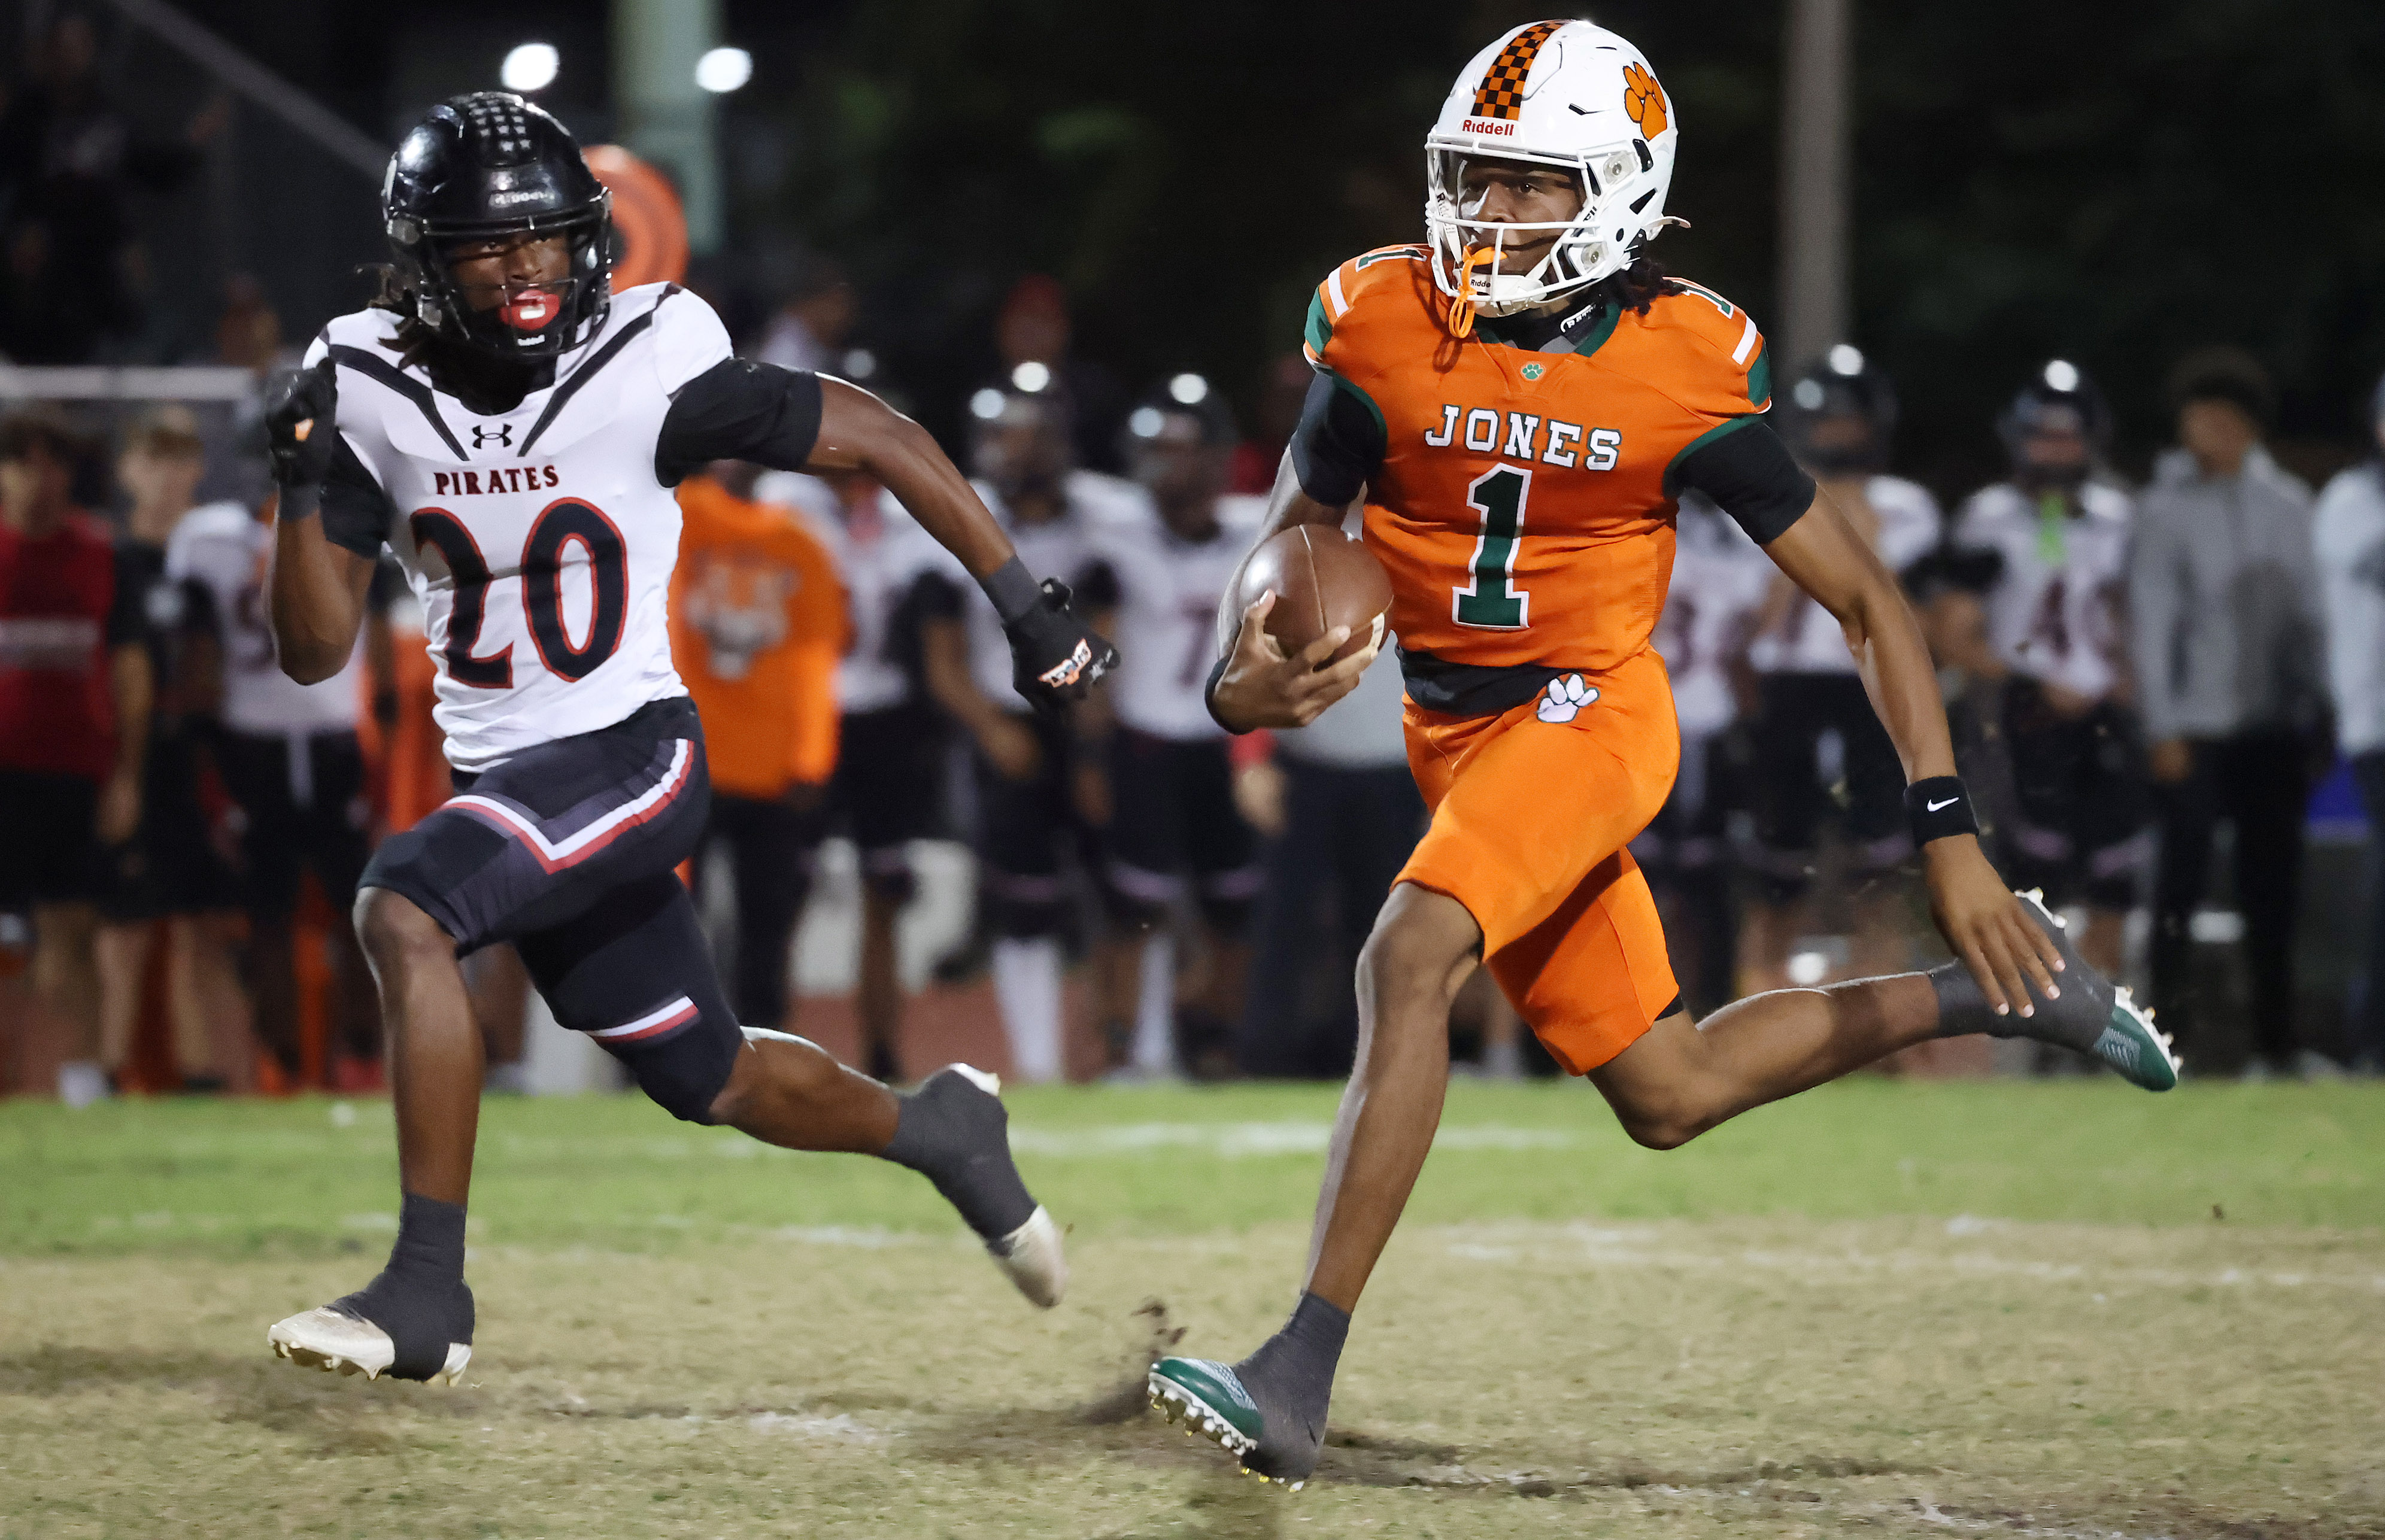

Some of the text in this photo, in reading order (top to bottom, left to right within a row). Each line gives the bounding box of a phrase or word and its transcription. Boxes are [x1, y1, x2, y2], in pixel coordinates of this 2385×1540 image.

[1462, 120, 1514, 136] Riddell
[1424, 403, 1622, 472] JONES
[433, 464, 559, 495] PIRATES
[1452, 462, 1533, 630] 1
[409, 496, 629, 688] 20
